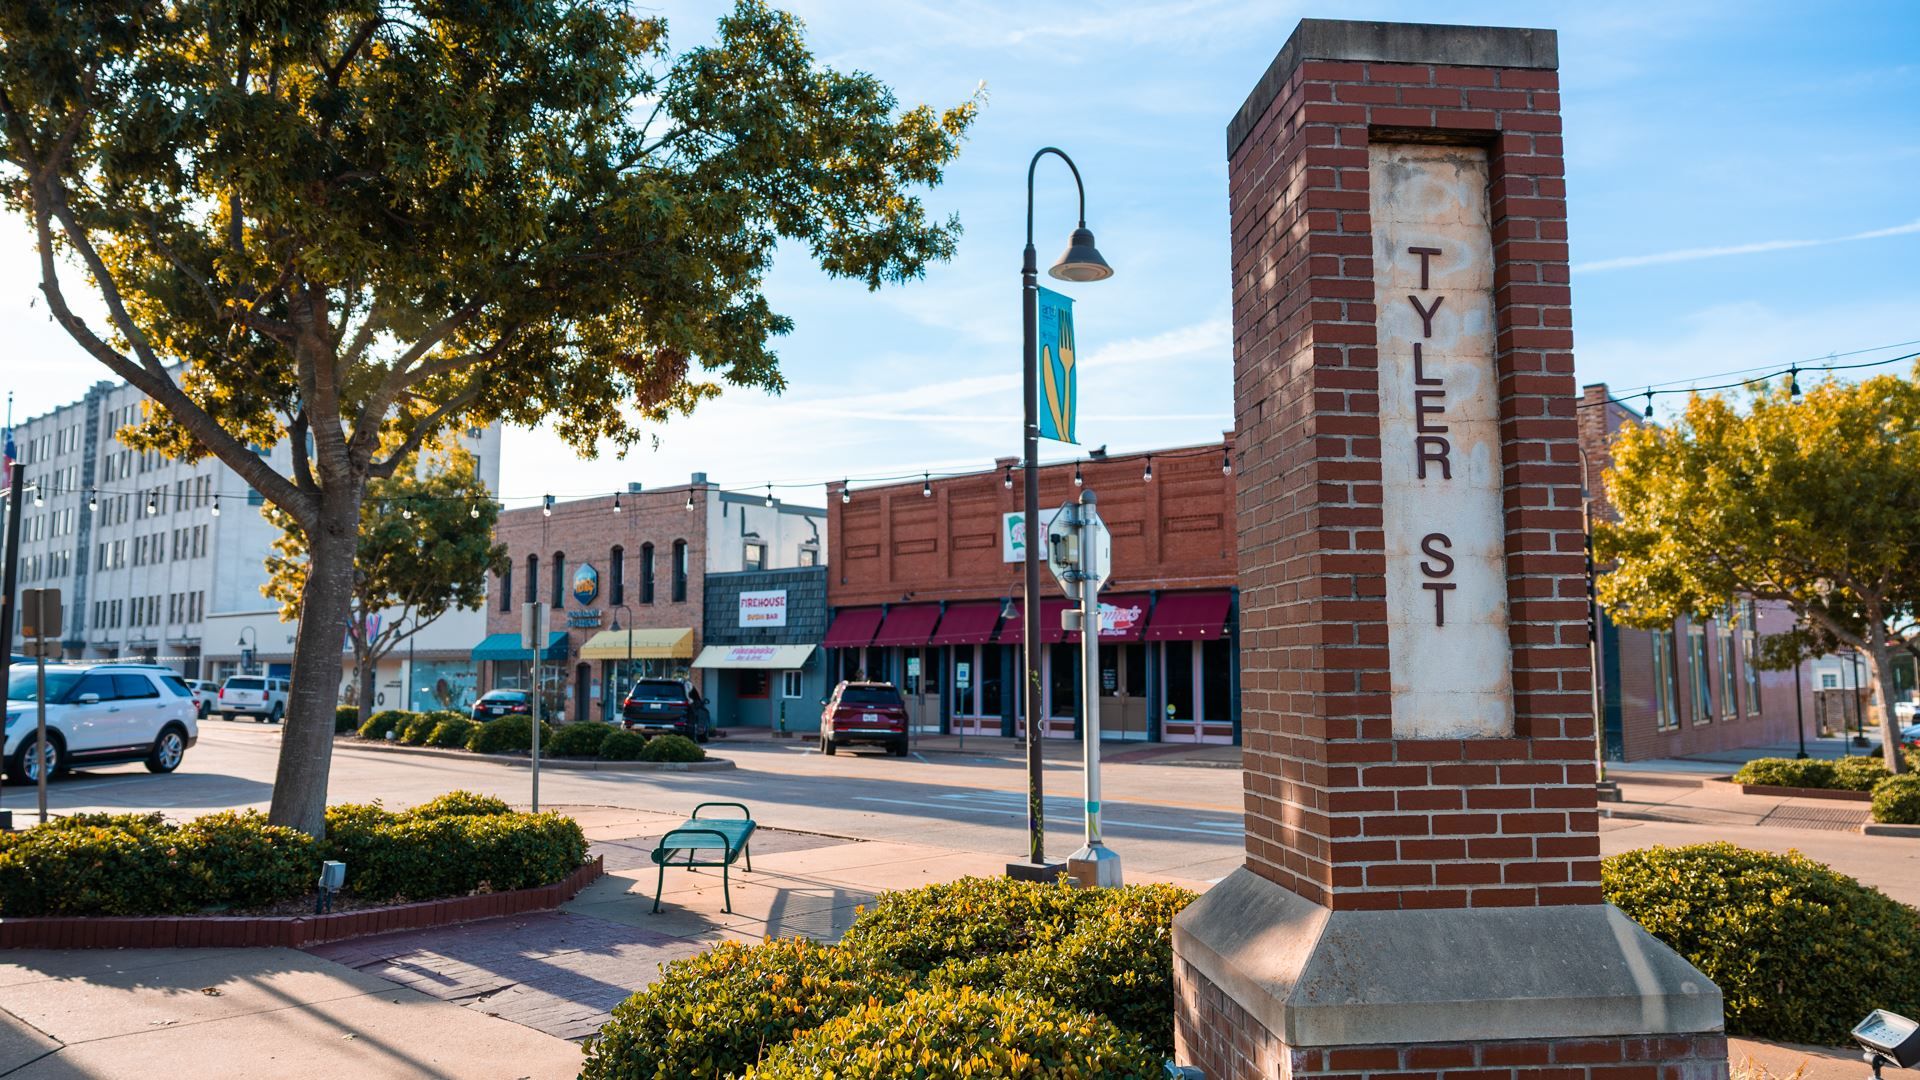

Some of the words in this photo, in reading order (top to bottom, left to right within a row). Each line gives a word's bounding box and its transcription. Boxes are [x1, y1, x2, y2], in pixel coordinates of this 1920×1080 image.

[1408, 246, 1452, 480] TYLER
[741, 596, 785, 608] FIREHOUSE
[1420, 532, 1457, 627] ST
